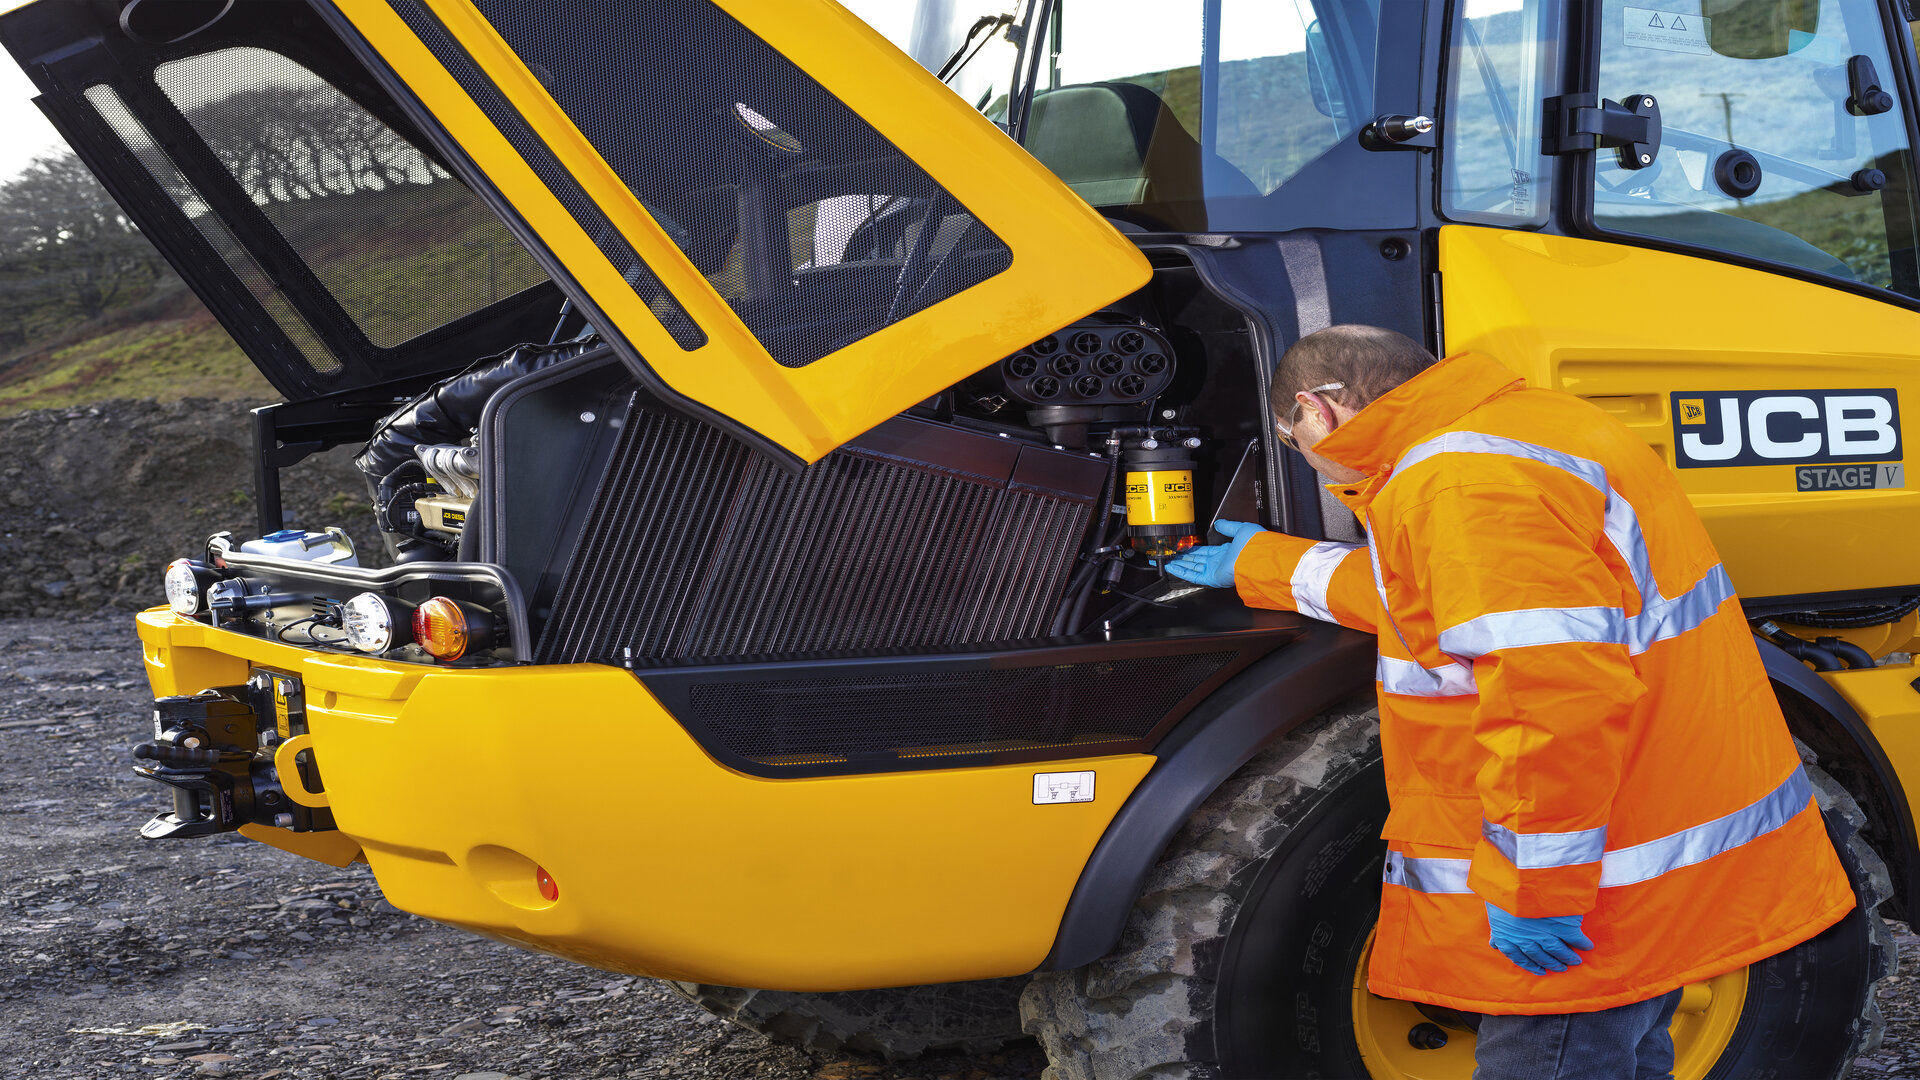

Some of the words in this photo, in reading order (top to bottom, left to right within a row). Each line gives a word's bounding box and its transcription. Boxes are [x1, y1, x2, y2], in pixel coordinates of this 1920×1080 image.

[1682, 395, 1897, 461] JCB
[1165, 484, 1191, 492] JCB
[1799, 468, 1872, 489] STAGE
[1885, 466, 1898, 486] V
